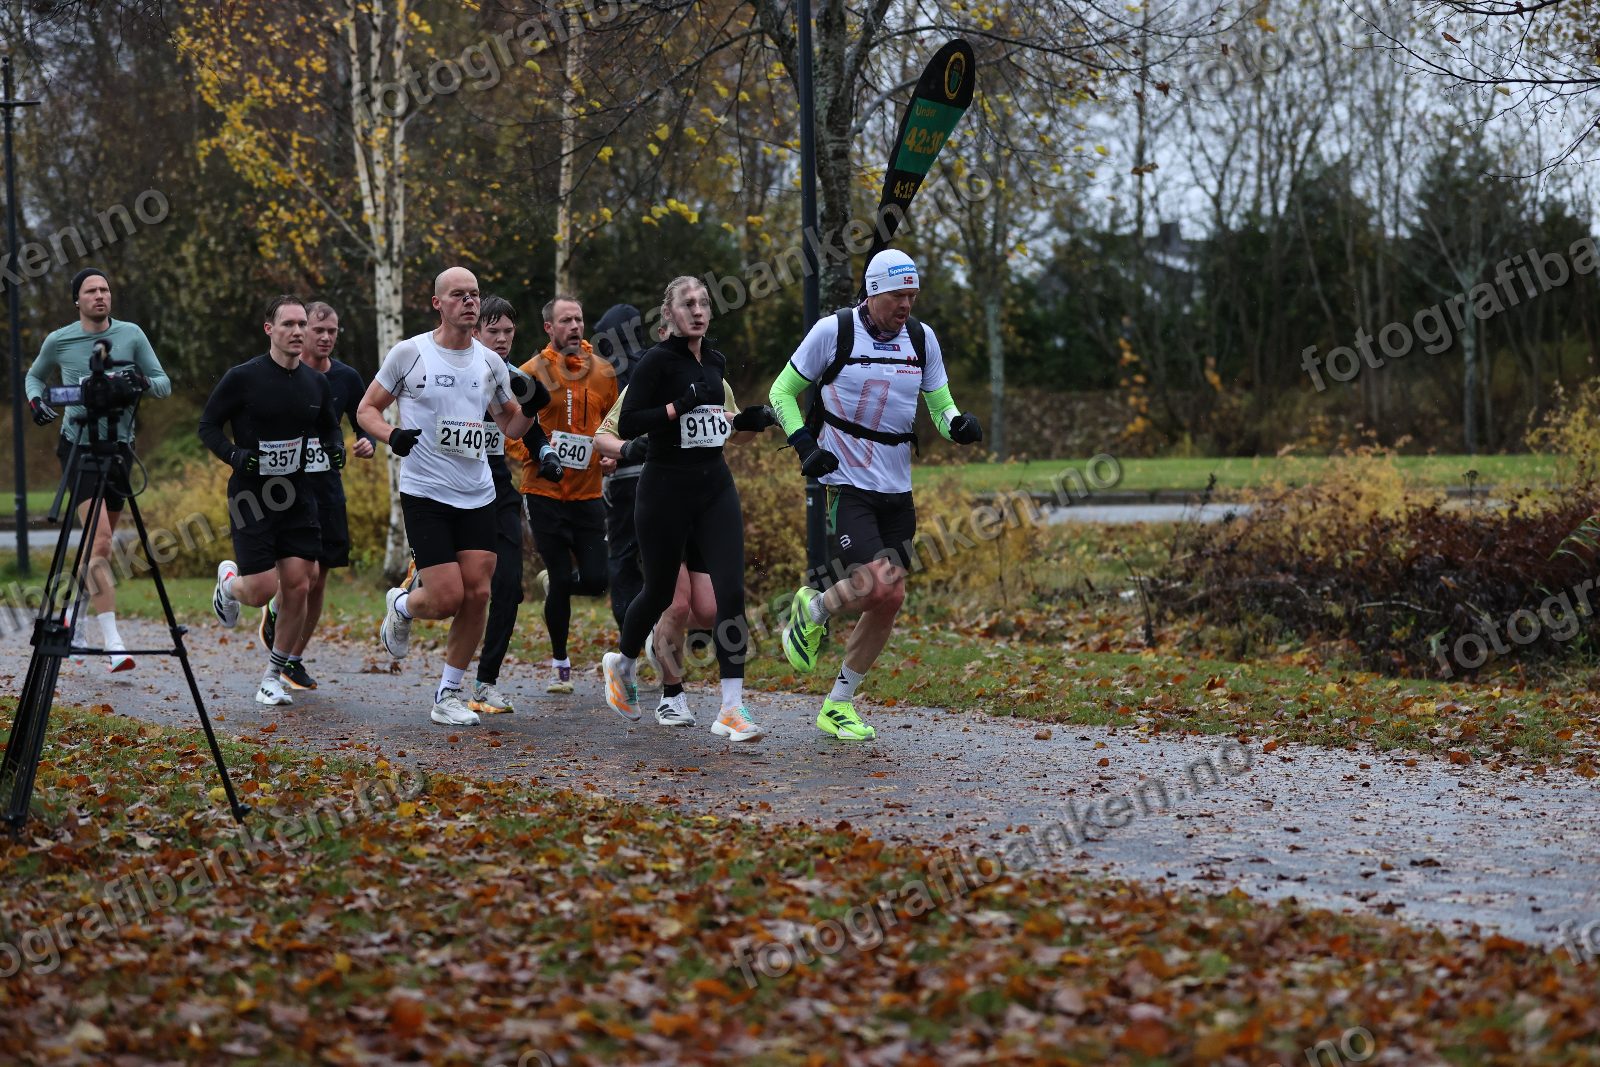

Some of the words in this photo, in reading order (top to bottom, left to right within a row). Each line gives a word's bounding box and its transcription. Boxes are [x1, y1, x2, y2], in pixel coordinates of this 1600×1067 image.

[915, 104, 937, 118] Under
[893, 180, 915, 200] 4:15
[440, 427, 483, 449] 2140
[268, 449, 296, 467] 357
[558, 442, 586, 462] 640
